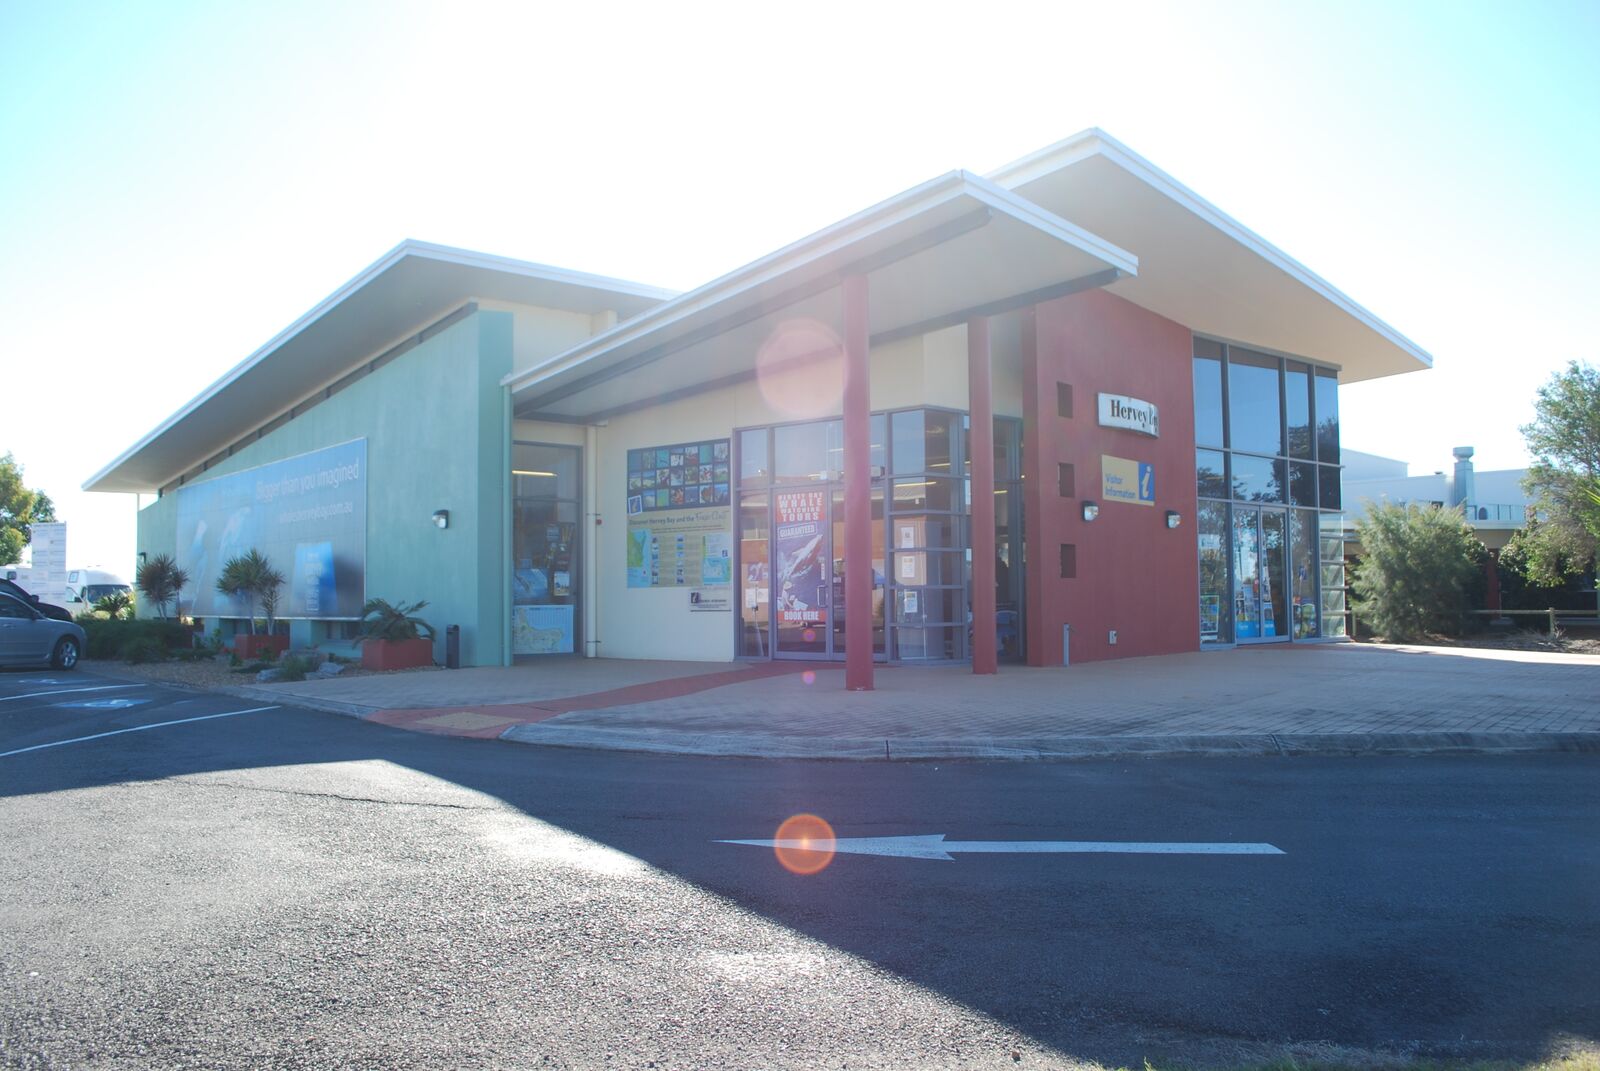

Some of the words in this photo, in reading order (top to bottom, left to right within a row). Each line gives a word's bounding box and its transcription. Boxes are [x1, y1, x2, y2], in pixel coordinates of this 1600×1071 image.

[1111, 399, 1147, 428] Hervey
[299, 474, 316, 495] you
[317, 457, 359, 489] imagined
[1105, 474, 1123, 484] Visitor
[1105, 486, 1136, 499] Information
[779, 498, 823, 508] WHALE
[780, 506, 820, 514] WATCHING
[667, 516, 675, 525] Bay
[676, 515, 685, 523] and
[782, 512, 819, 522] TOURS
[780, 525, 815, 538] GUARANTEED
[784, 611, 802, 621] BOOK
[802, 610, 819, 620] HERE
